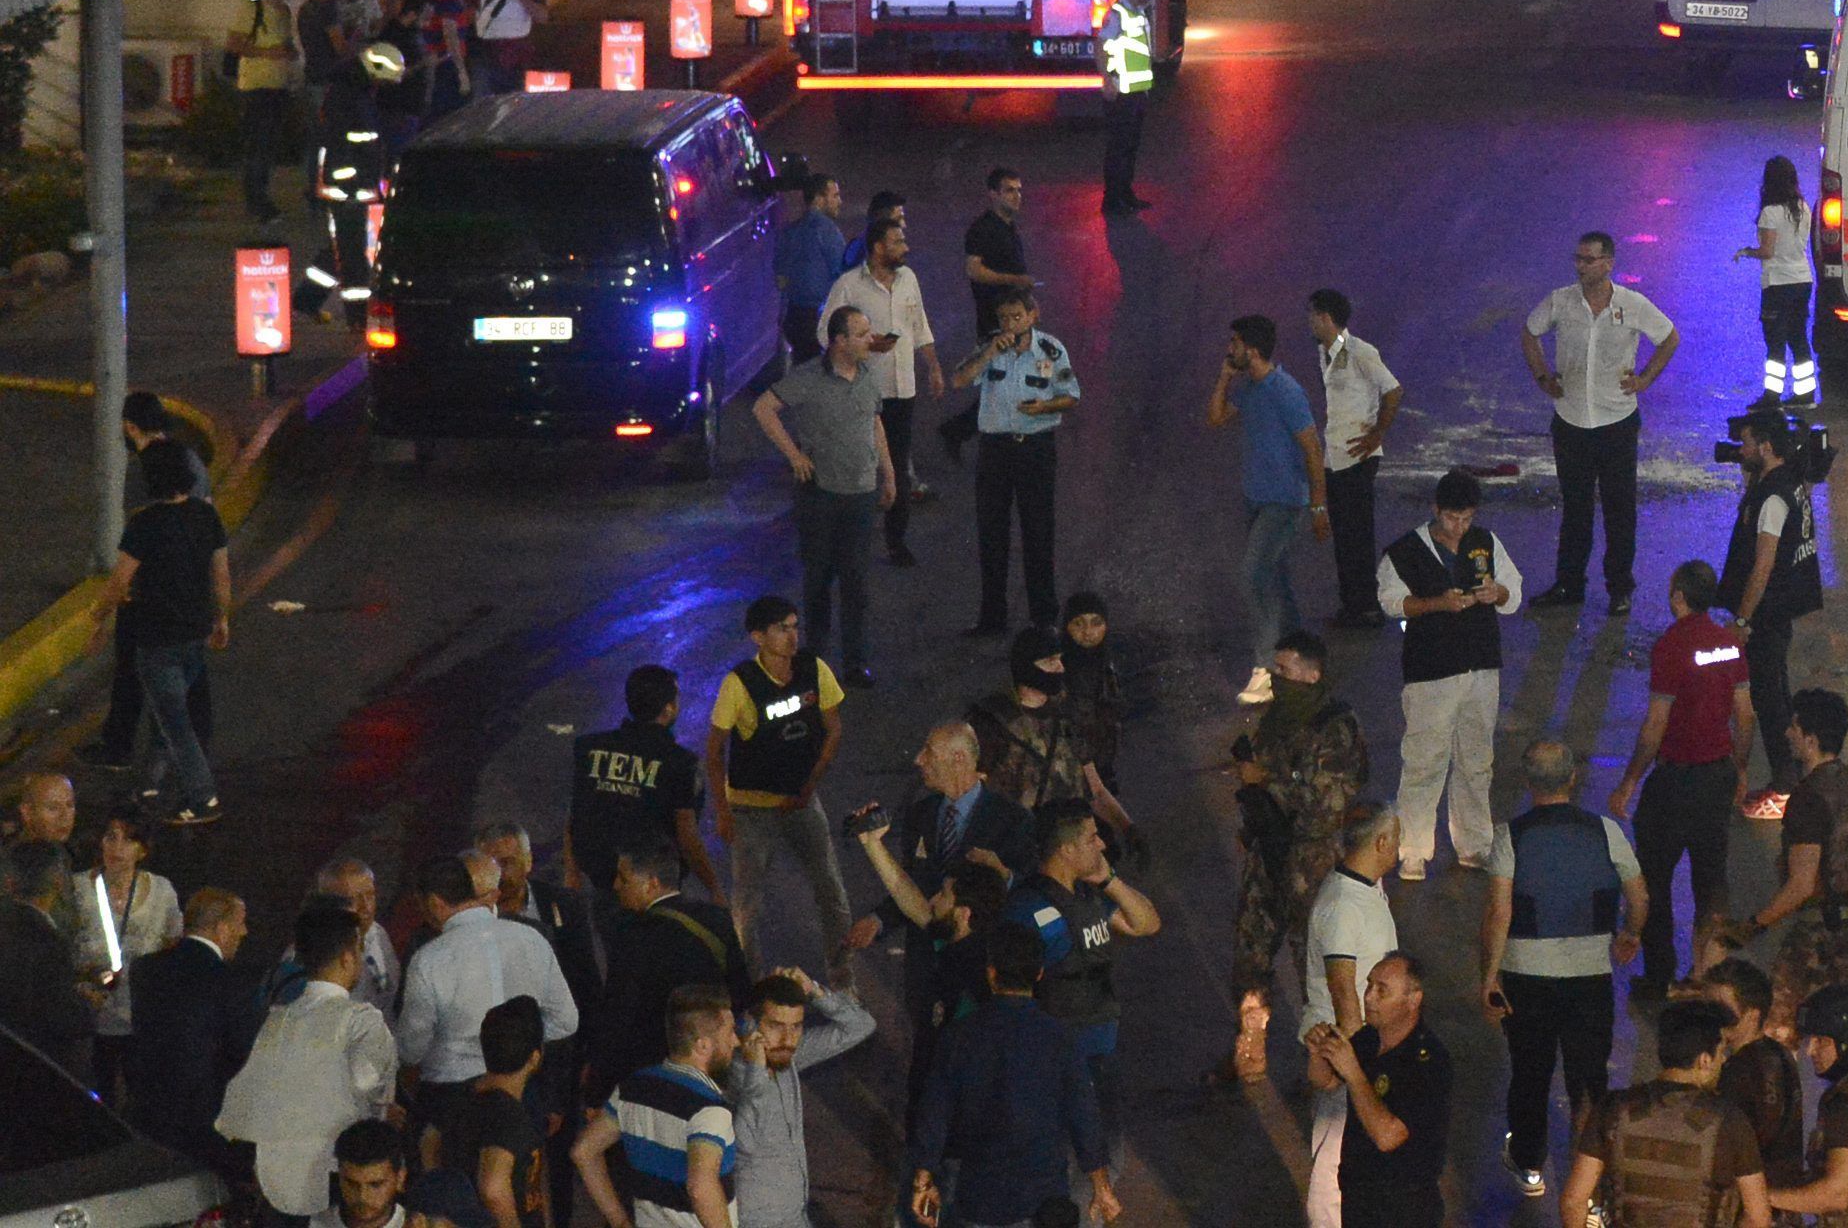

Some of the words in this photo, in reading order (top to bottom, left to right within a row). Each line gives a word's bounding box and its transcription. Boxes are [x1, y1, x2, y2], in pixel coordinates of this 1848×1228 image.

[1692, 4, 1704, 15] 34
[1722, 7, 1747, 18] 5022
[550, 322, 565, 335] 88
[588, 749, 662, 788] TEM
